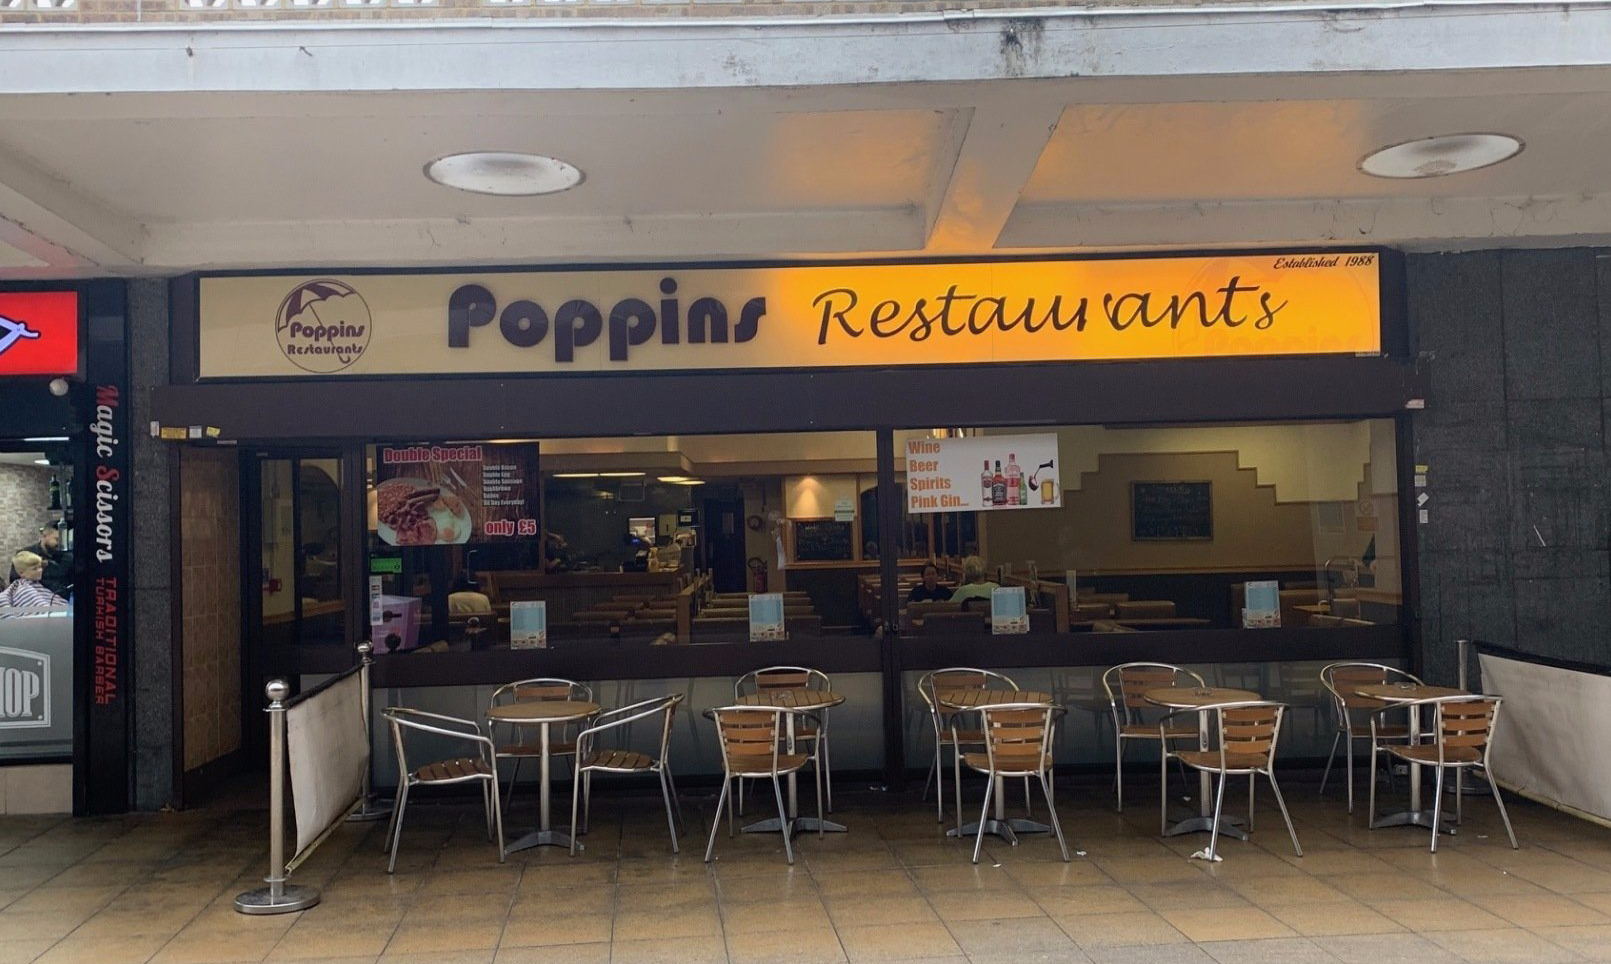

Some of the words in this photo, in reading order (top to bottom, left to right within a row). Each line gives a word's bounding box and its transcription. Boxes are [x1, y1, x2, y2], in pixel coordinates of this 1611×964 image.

[1273, 256, 1339, 270] Established
[1344, 255, 1376, 267] 1988
[448, 277, 767, 363] Poppins
[812, 275, 1288, 345] Restaurants
[290, 320, 365, 342] Poppins
[287, 343, 363, 355] Restaurants
[89, 384, 120, 459] Magic
[383, 446, 431, 463] Double
[431, 445, 482, 463] Special
[908, 441, 941, 454] Wine
[909, 459, 939, 472] Beer
[909, 477, 952, 492] Spirits
[911, 496, 940, 508] Pink
[96, 465, 120, 563] Scissors
[484, 519, 515, 535] only
[517, 518, 537, 535] £5
[95, 578, 105, 639] TURKISH
[104, 577, 117, 705] TRADITIONAL
[95, 646, 105, 705] BARBER
